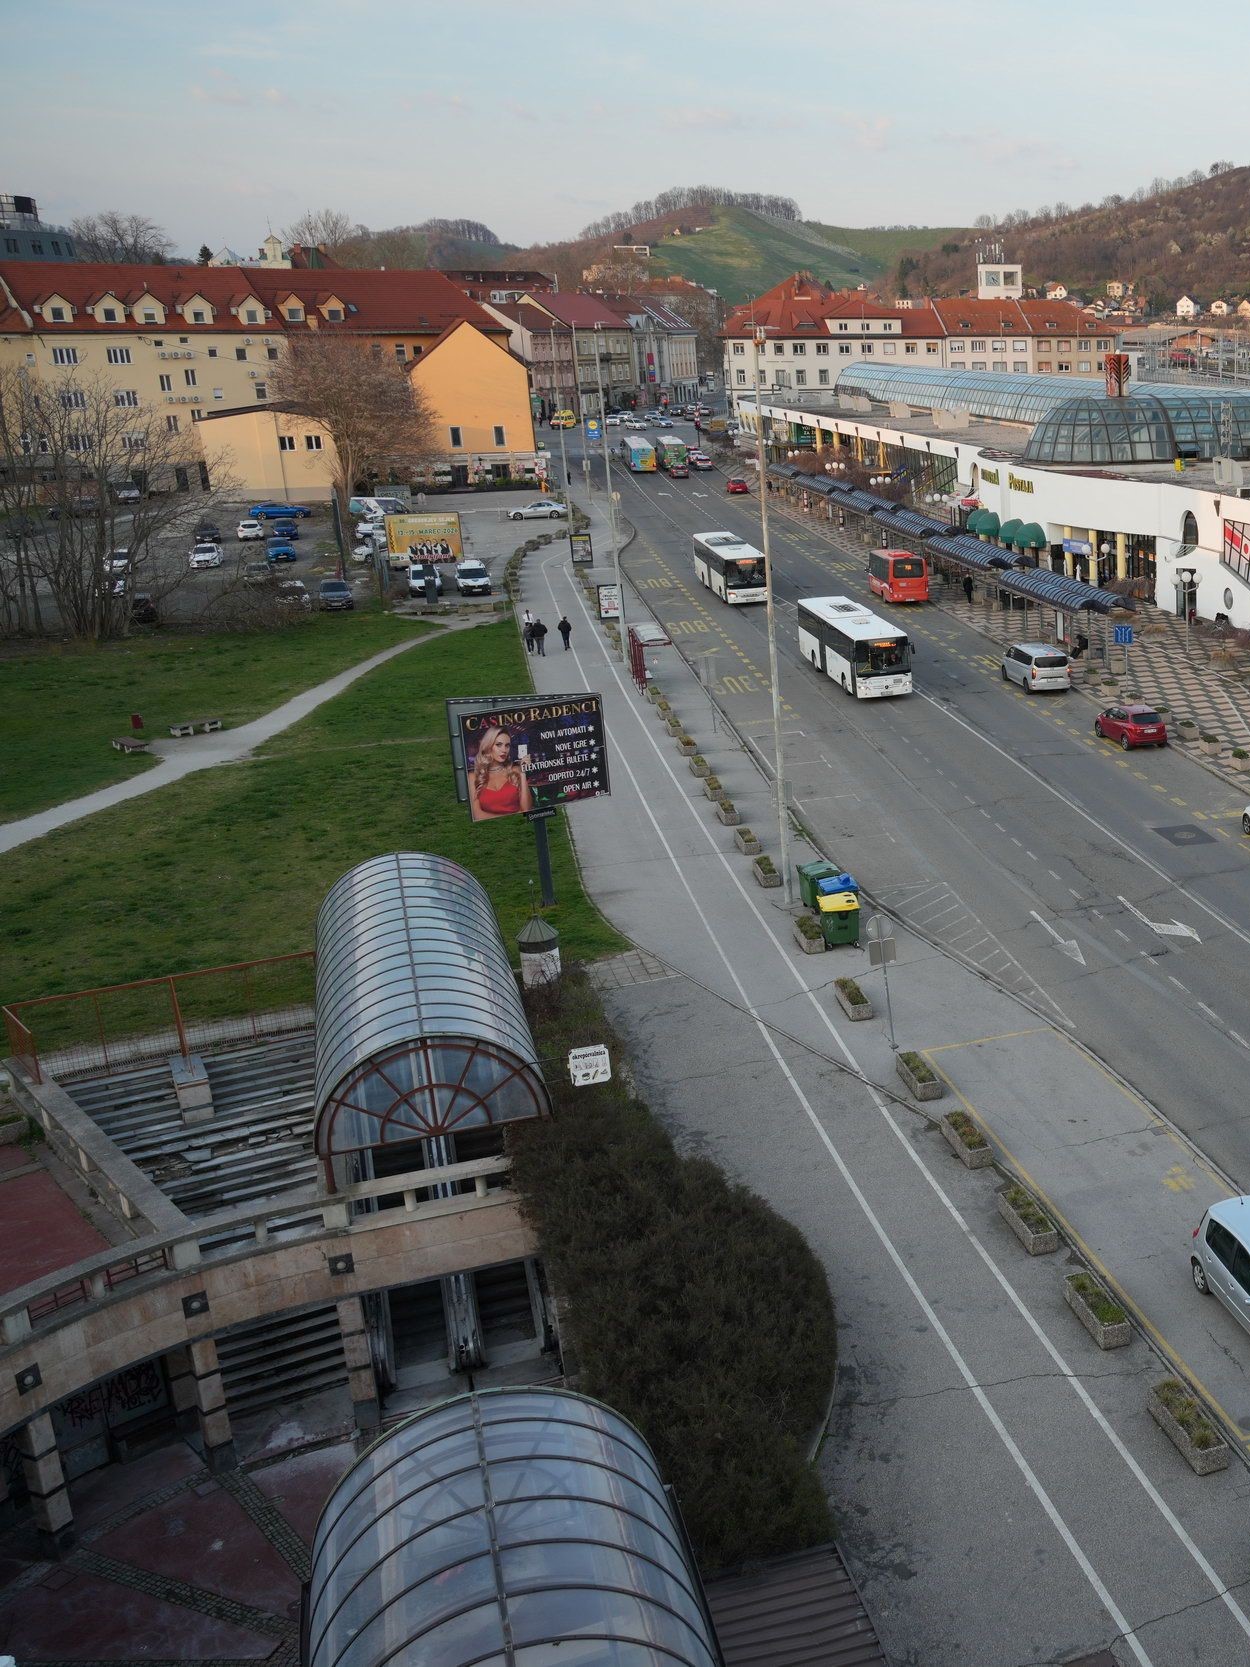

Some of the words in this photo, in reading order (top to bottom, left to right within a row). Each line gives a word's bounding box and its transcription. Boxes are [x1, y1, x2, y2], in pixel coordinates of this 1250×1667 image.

[1008, 472, 1034, 494] POSTAJA
[666, 620, 710, 635] BUS
[466, 712, 526, 730] CASINO
[529, 700, 597, 721] RADENCI
[540, 731, 556, 740] NOVI
[557, 725, 587, 738] AVTOMATI
[555, 743, 572, 752] NOVE
[573, 739, 588, 748] IGRE
[521, 757, 565, 772] ELEKTRONSKE
[566, 753, 590, 765] RULETE
[548, 770, 574, 782] ODPRTO
[576, 768, 591, 778] 24/7
[563, 783, 581, 793] OPEN
[581, 781, 592, 790] AIR
